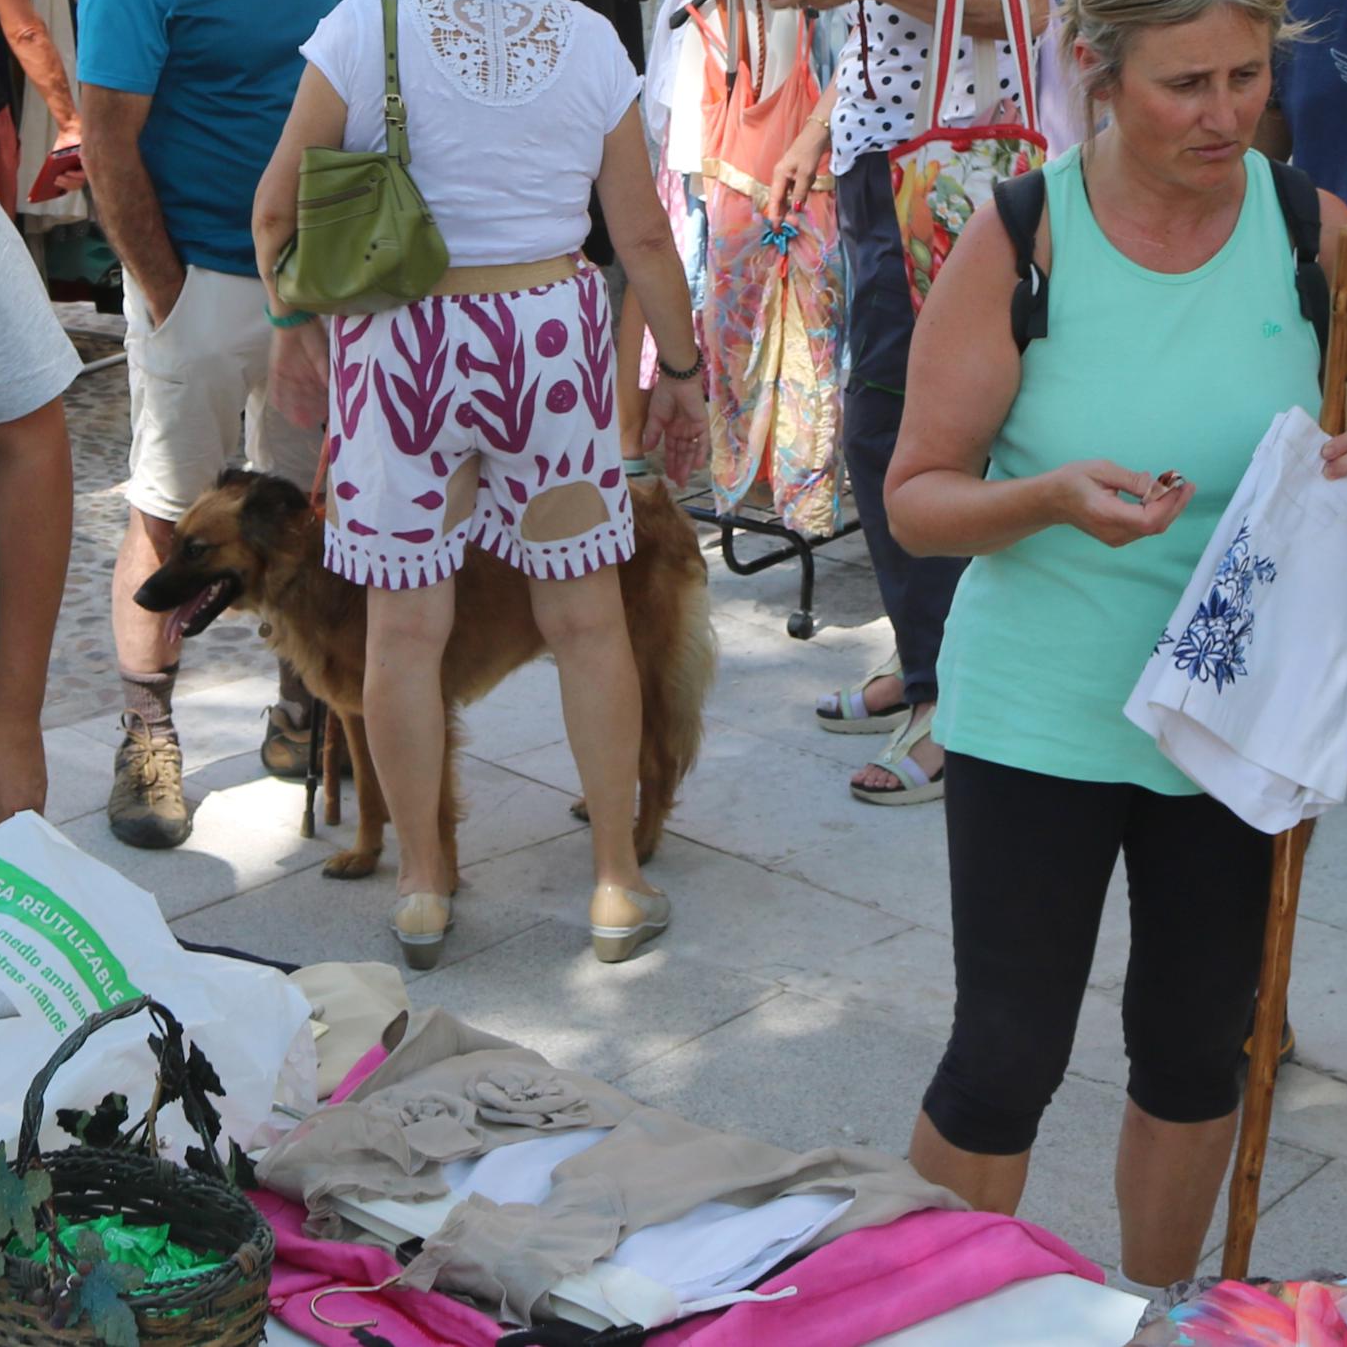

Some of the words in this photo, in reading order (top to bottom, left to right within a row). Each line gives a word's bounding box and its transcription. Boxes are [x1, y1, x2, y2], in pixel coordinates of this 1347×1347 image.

[16, 893, 125, 1006] REUTILIZABLE
[25, 980, 69, 1038] manos.
[40, 965, 90, 1022] ambien
